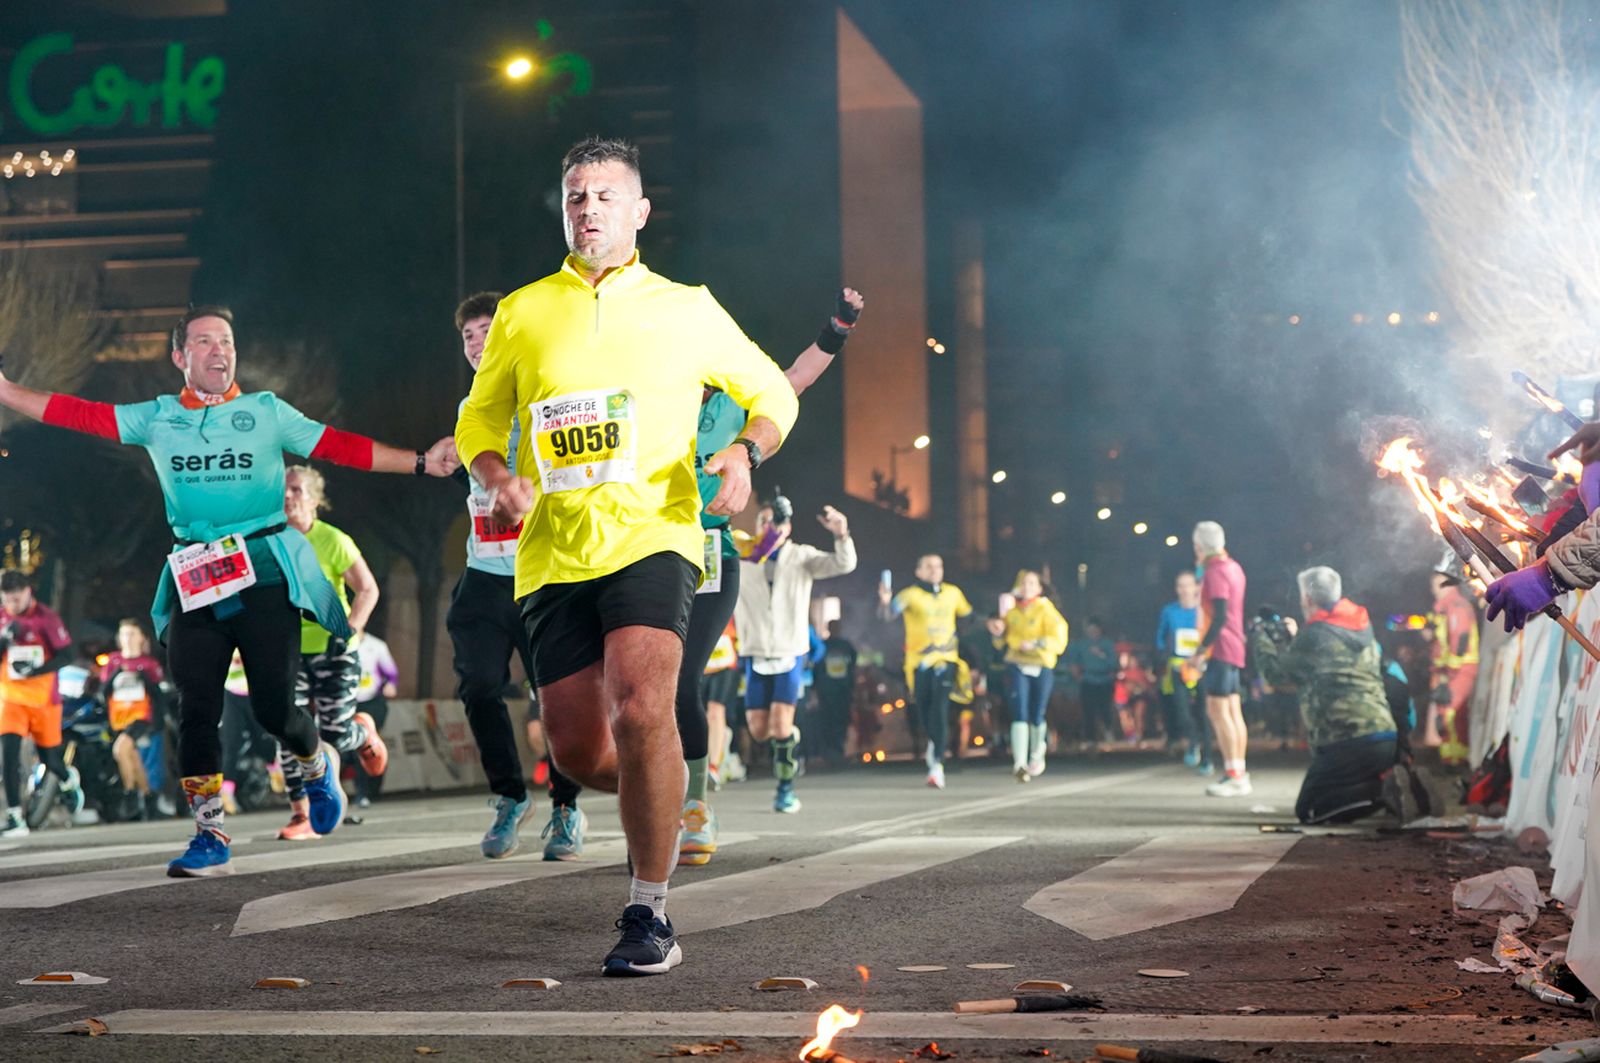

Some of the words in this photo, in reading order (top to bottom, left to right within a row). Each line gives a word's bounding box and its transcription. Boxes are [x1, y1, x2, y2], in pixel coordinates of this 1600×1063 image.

[9, 31, 226, 134] Corte
[552, 403, 582, 416] NOCHE
[584, 401, 597, 411] DE
[543, 418, 562, 431] SAN
[550, 421, 620, 458] 9058
[171, 447, 253, 472] serás
[565, 454, 592, 465] ANTONIO
[185, 476, 200, 484] QUE
[204, 474, 236, 483] QUIERAS
[240, 473, 252, 481] SER
